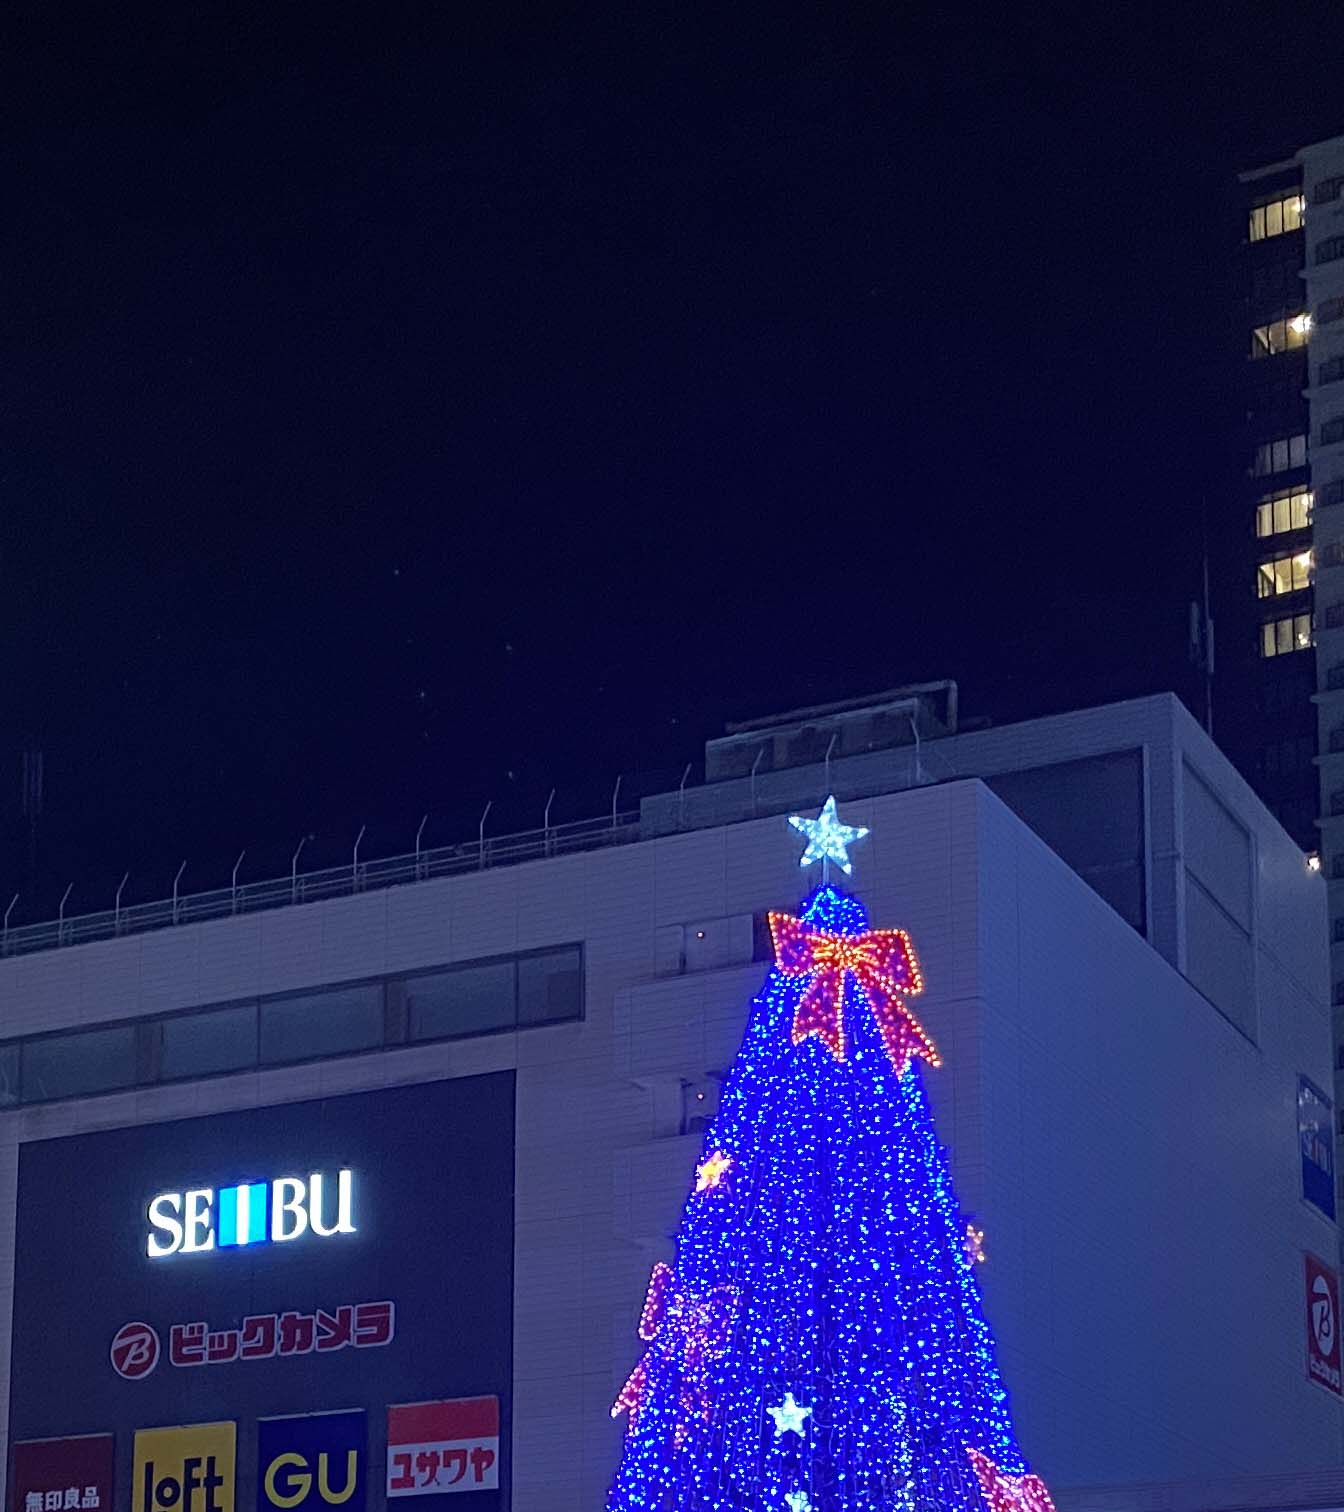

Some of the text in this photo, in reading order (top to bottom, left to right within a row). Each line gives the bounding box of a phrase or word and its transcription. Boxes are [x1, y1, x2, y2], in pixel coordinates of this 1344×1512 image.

[147, 1169, 358, 1258] SEIBU
[170, 1301, 395, 1367] ビックカメラ
[264, 1450, 358, 1509] GU
[390, 1451, 495, 1491] ユサワヤ
